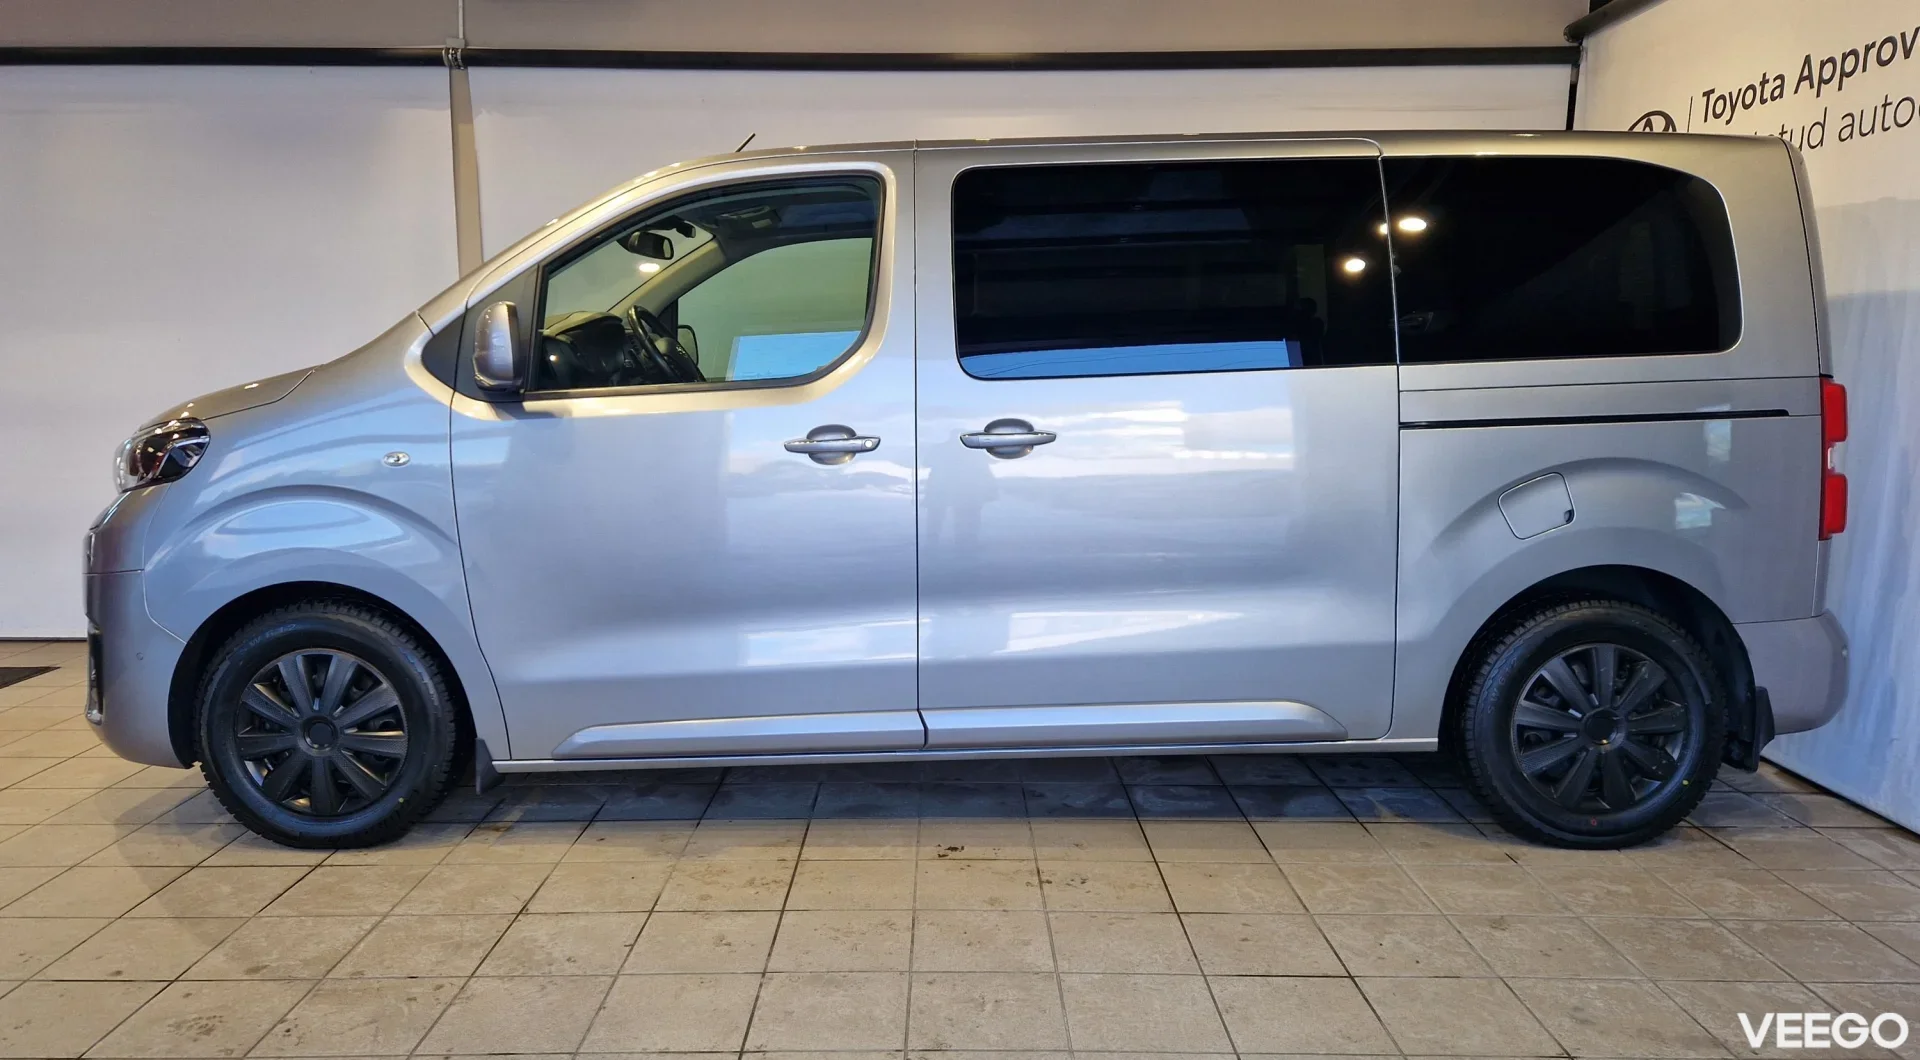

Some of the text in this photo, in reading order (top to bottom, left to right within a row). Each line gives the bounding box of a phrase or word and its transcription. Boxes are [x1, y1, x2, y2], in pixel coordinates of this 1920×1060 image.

[1702, 26, 1920, 125] Toyota Approv
[1838, 93, 1920, 143] auto
